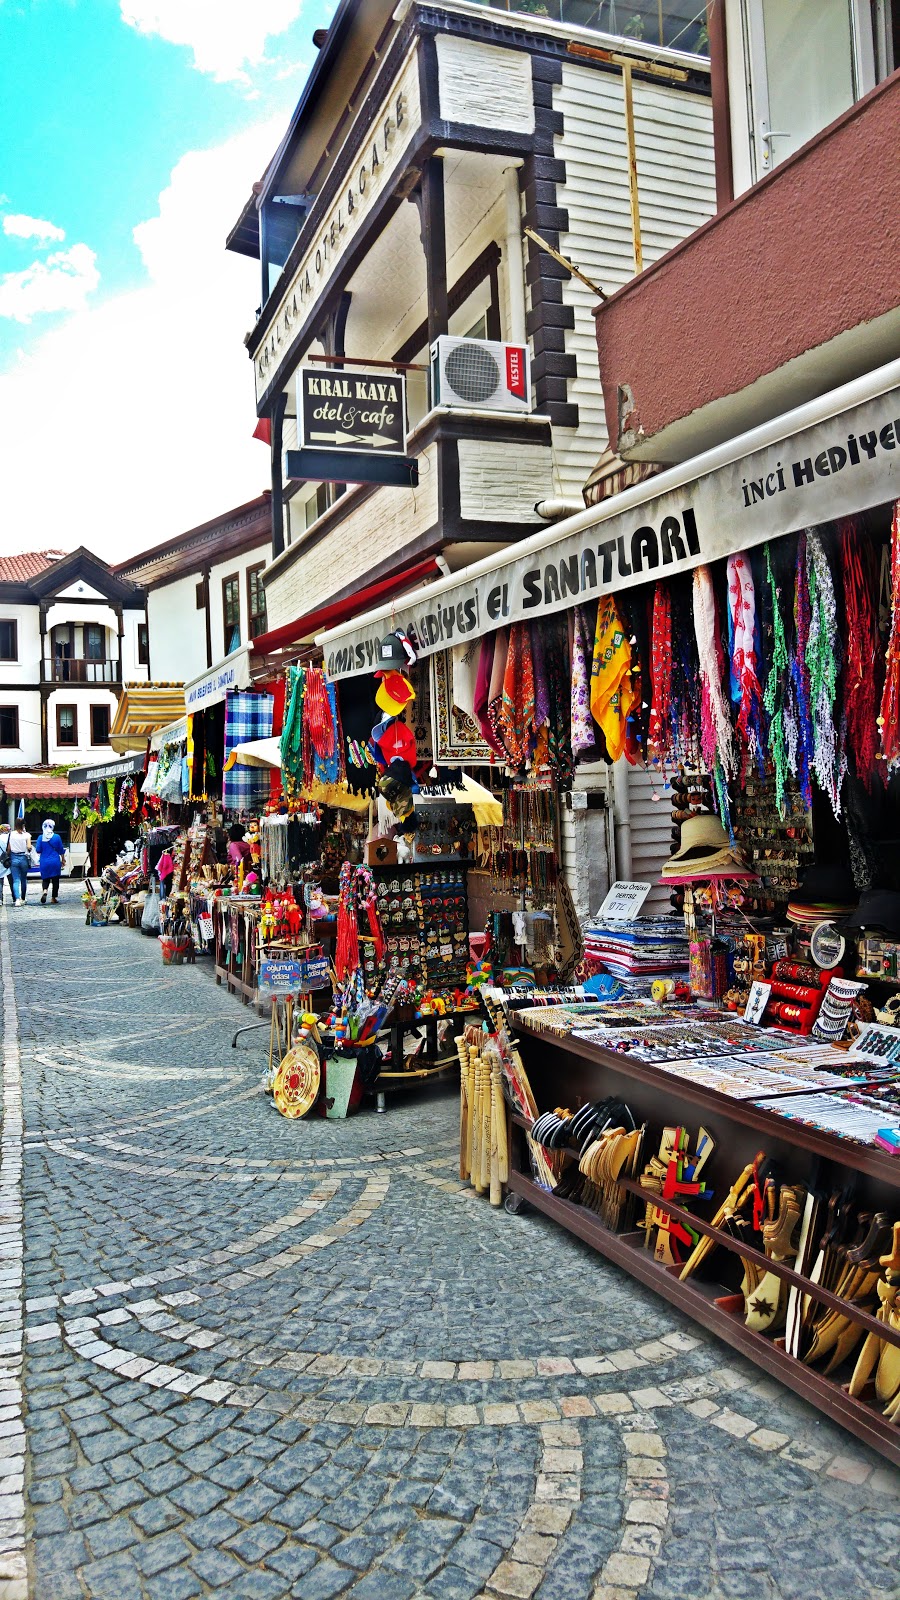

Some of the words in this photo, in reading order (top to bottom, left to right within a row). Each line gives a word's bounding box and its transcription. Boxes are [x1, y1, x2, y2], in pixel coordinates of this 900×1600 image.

[257, 327, 283, 378] KRAL
[284, 269, 312, 330] KAYA
[315, 208, 345, 274] OTEL
[347, 188, 356, 216] &
[358, 90, 407, 195] CAFE
[510, 351, 519, 387] VESTEL
[308, 377, 352, 399] KRAL
[356, 382, 398, 403] KAYA
[313, 401, 343, 422] otel
[341, 406, 361, 430] &
[361, 404, 395, 430] cafe
[742, 461, 787, 508] İNCİ
[397, 588, 481, 650] ELEDİYESİ
[487, 583, 510, 621] EL
[522, 507, 701, 610] SANATLARI
[267, 964, 294, 973] oğlumun
